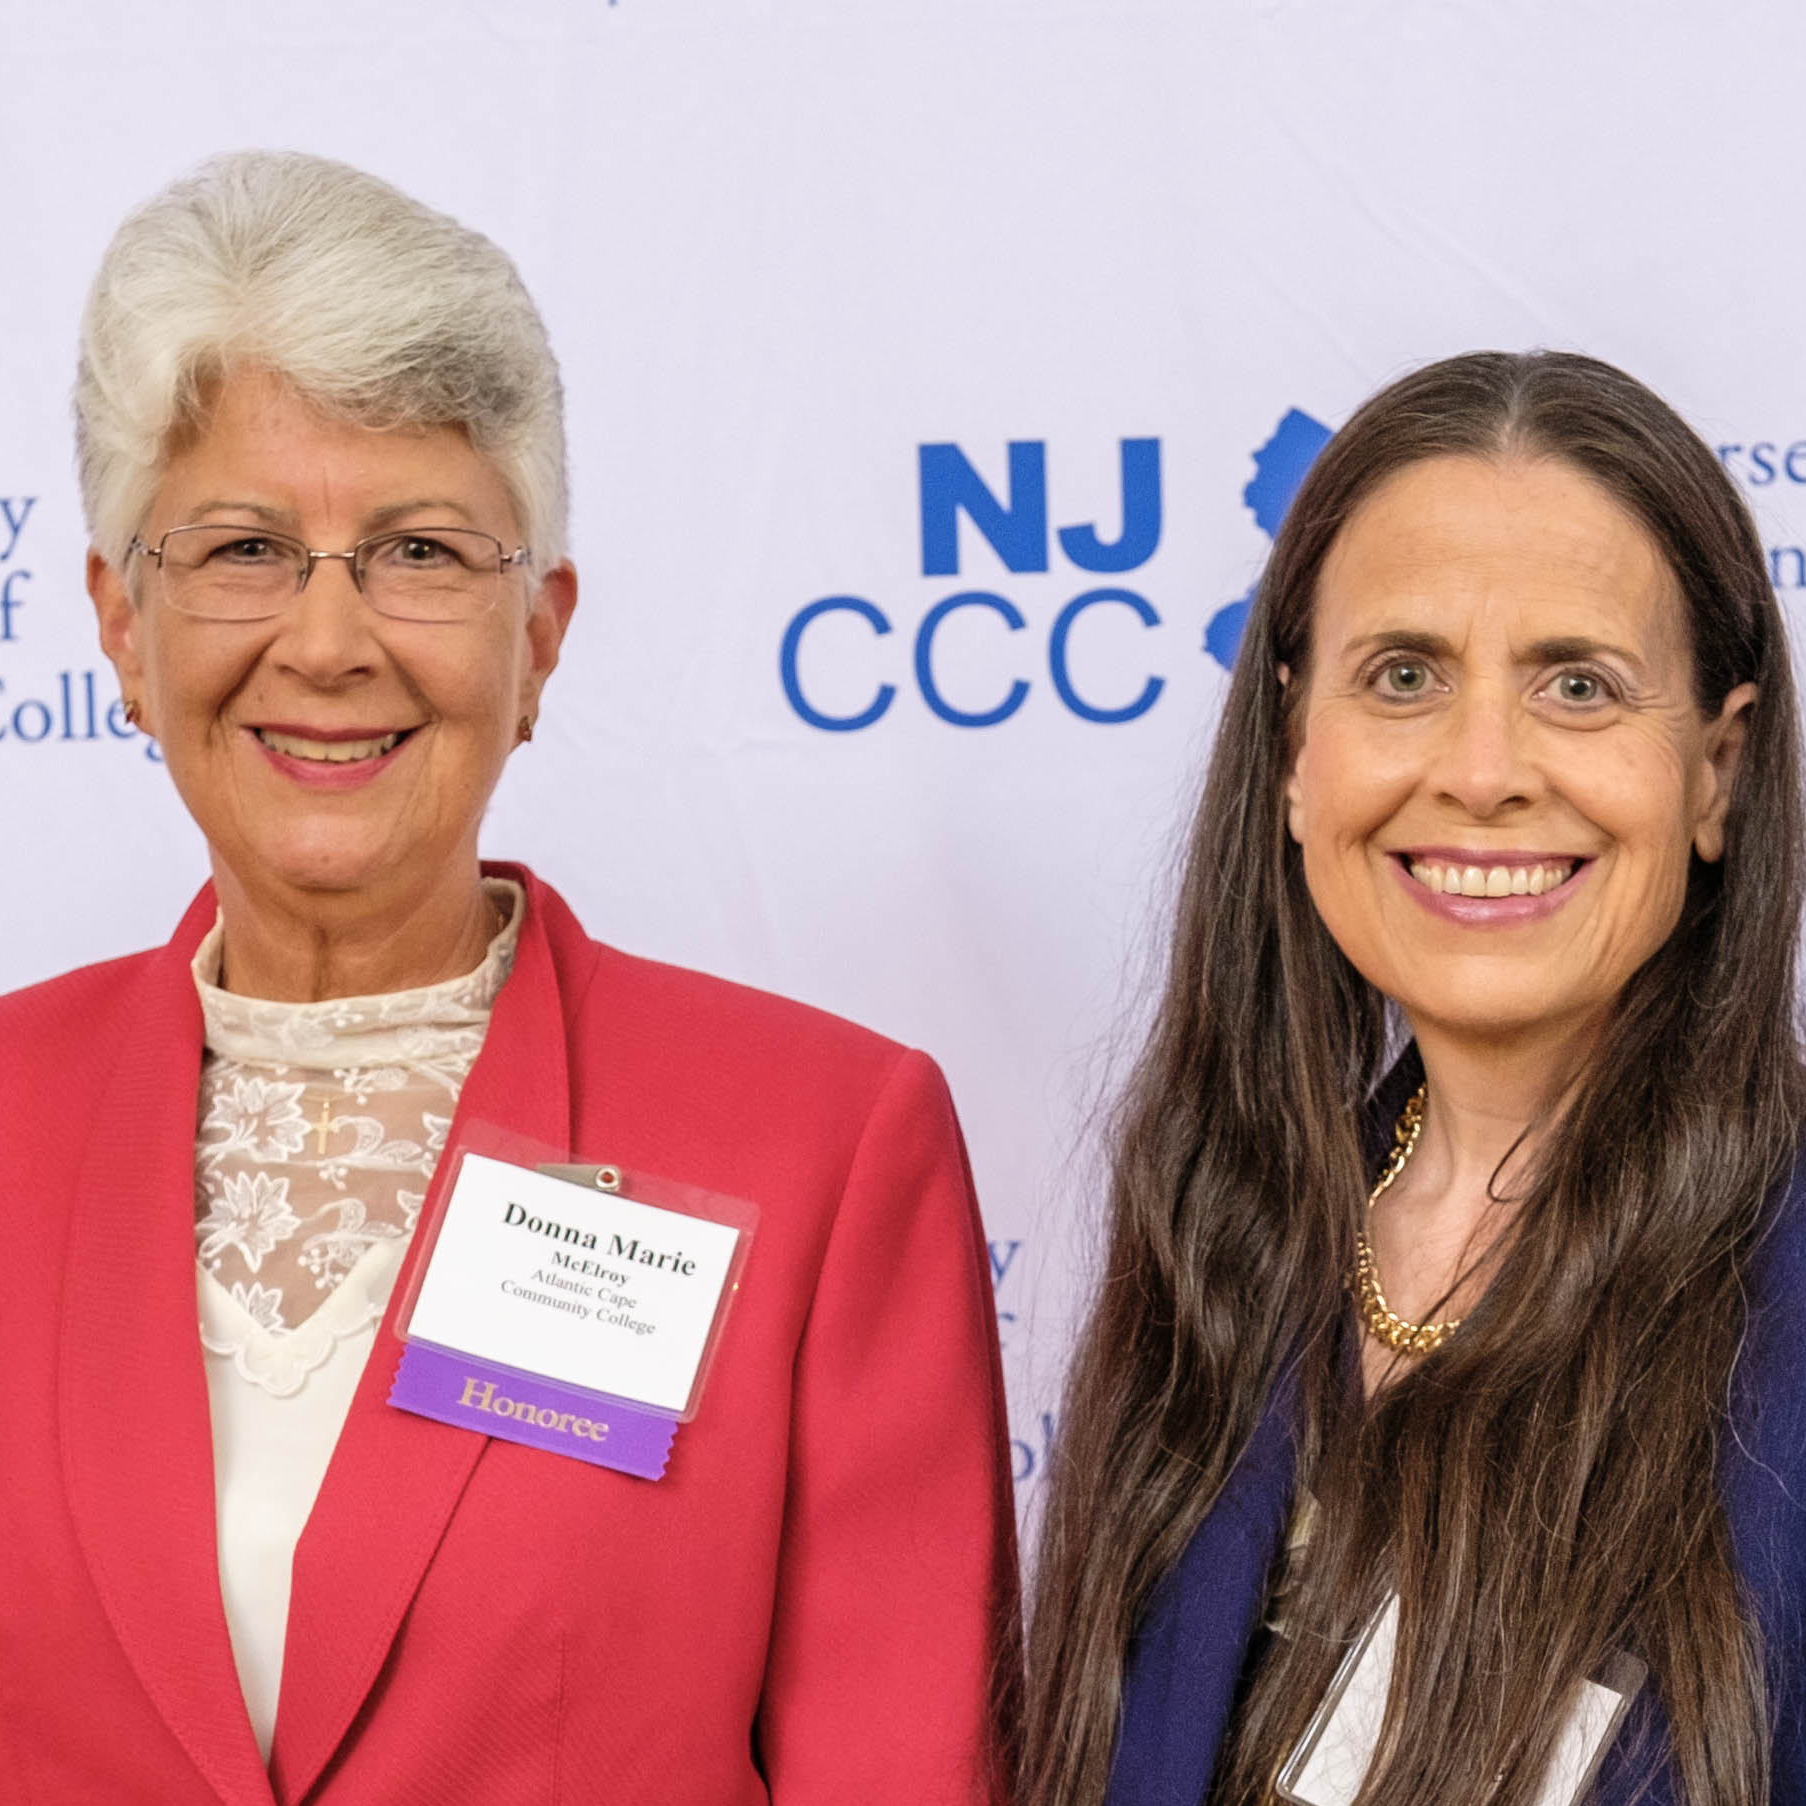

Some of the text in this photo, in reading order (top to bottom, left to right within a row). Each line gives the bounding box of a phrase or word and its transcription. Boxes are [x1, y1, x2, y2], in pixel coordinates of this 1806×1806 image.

[917, 436, 1162, 577] NJ
[779, 586, 1166, 734] CCC
[503, 1201, 697, 1277] Donna Marie
[551, 1250, 630, 1288] McElroy
[500, 1278, 657, 1336] Community College
[530, 1267, 638, 1319] Atlantic Cape
[456, 1374, 610, 1442] Honoree
